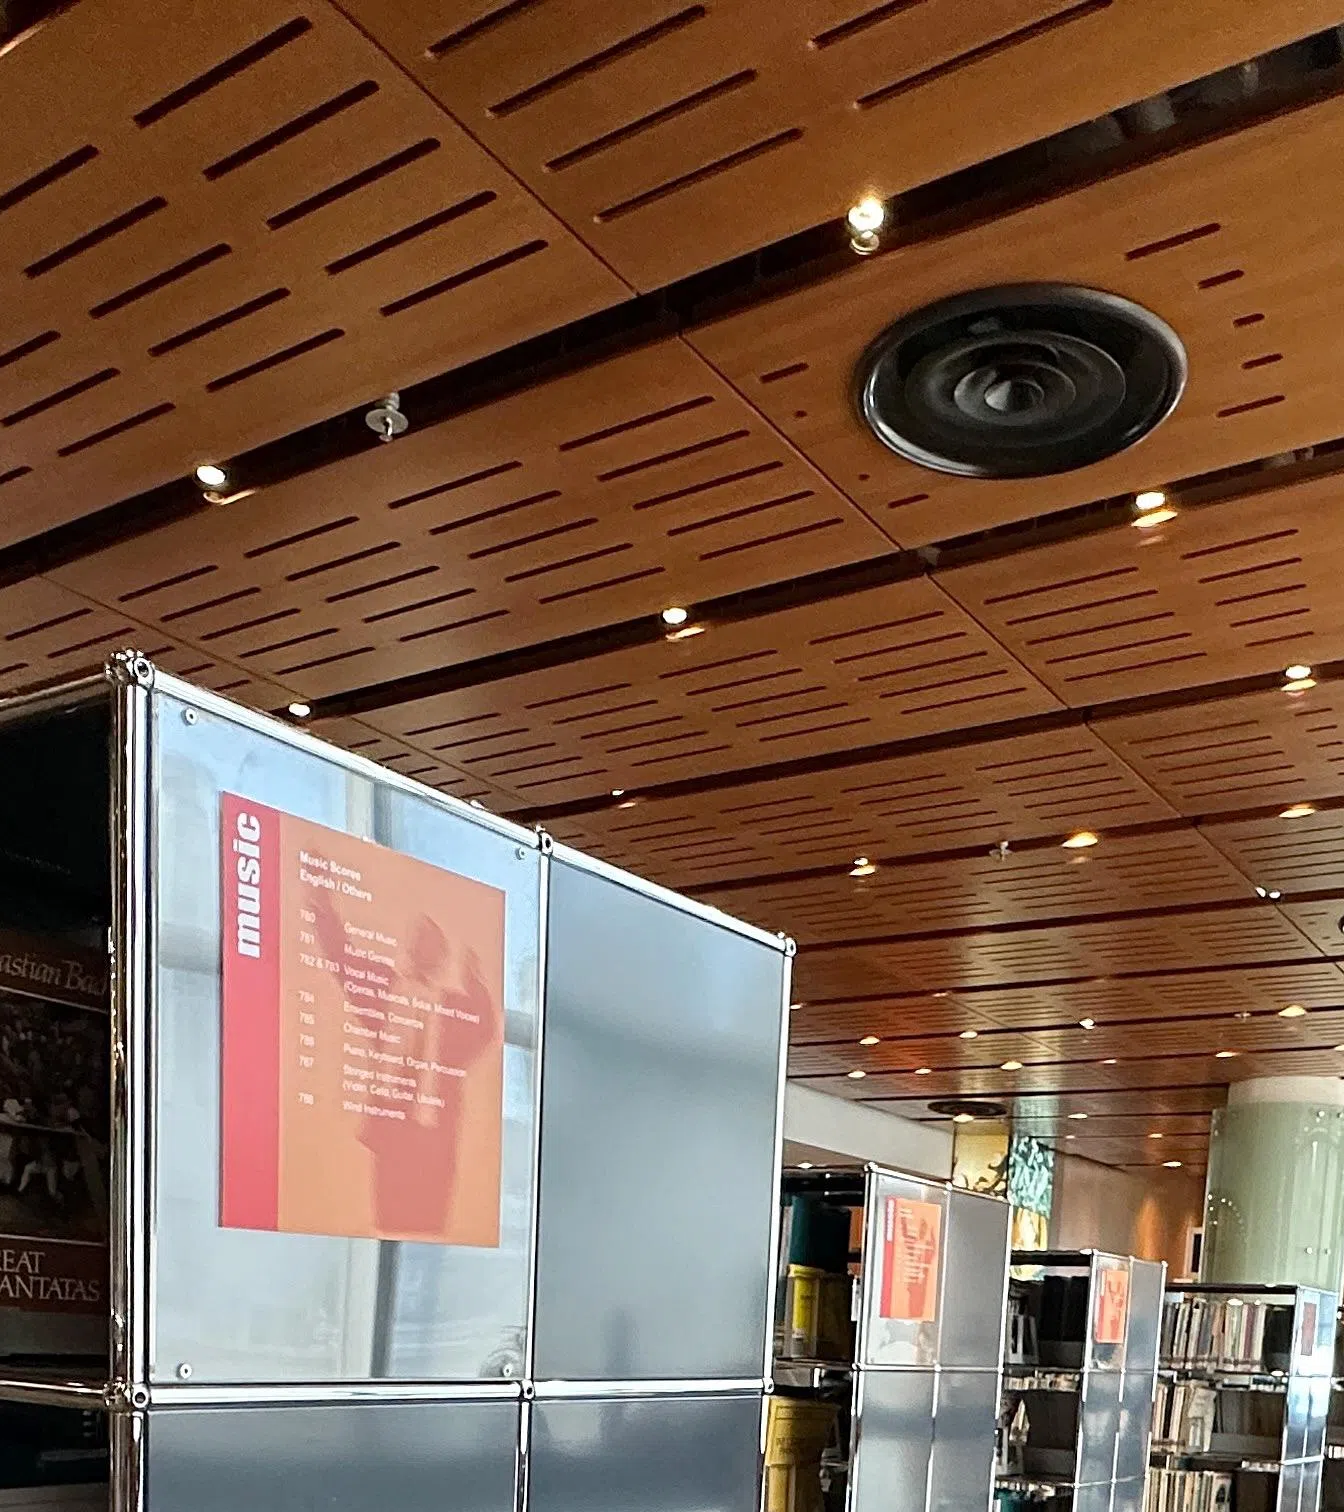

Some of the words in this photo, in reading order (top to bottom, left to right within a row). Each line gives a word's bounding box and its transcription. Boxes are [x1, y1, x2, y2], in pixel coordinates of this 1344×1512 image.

[299, 850, 329, 871] Music
[330, 861, 362, 882] Scores
[233, 812, 261, 959] music
[299, 868, 336, 891] English
[342, 882, 373, 903] Others
[366, 971, 390, 986] Music
[379, 1030, 401, 1044] Music
